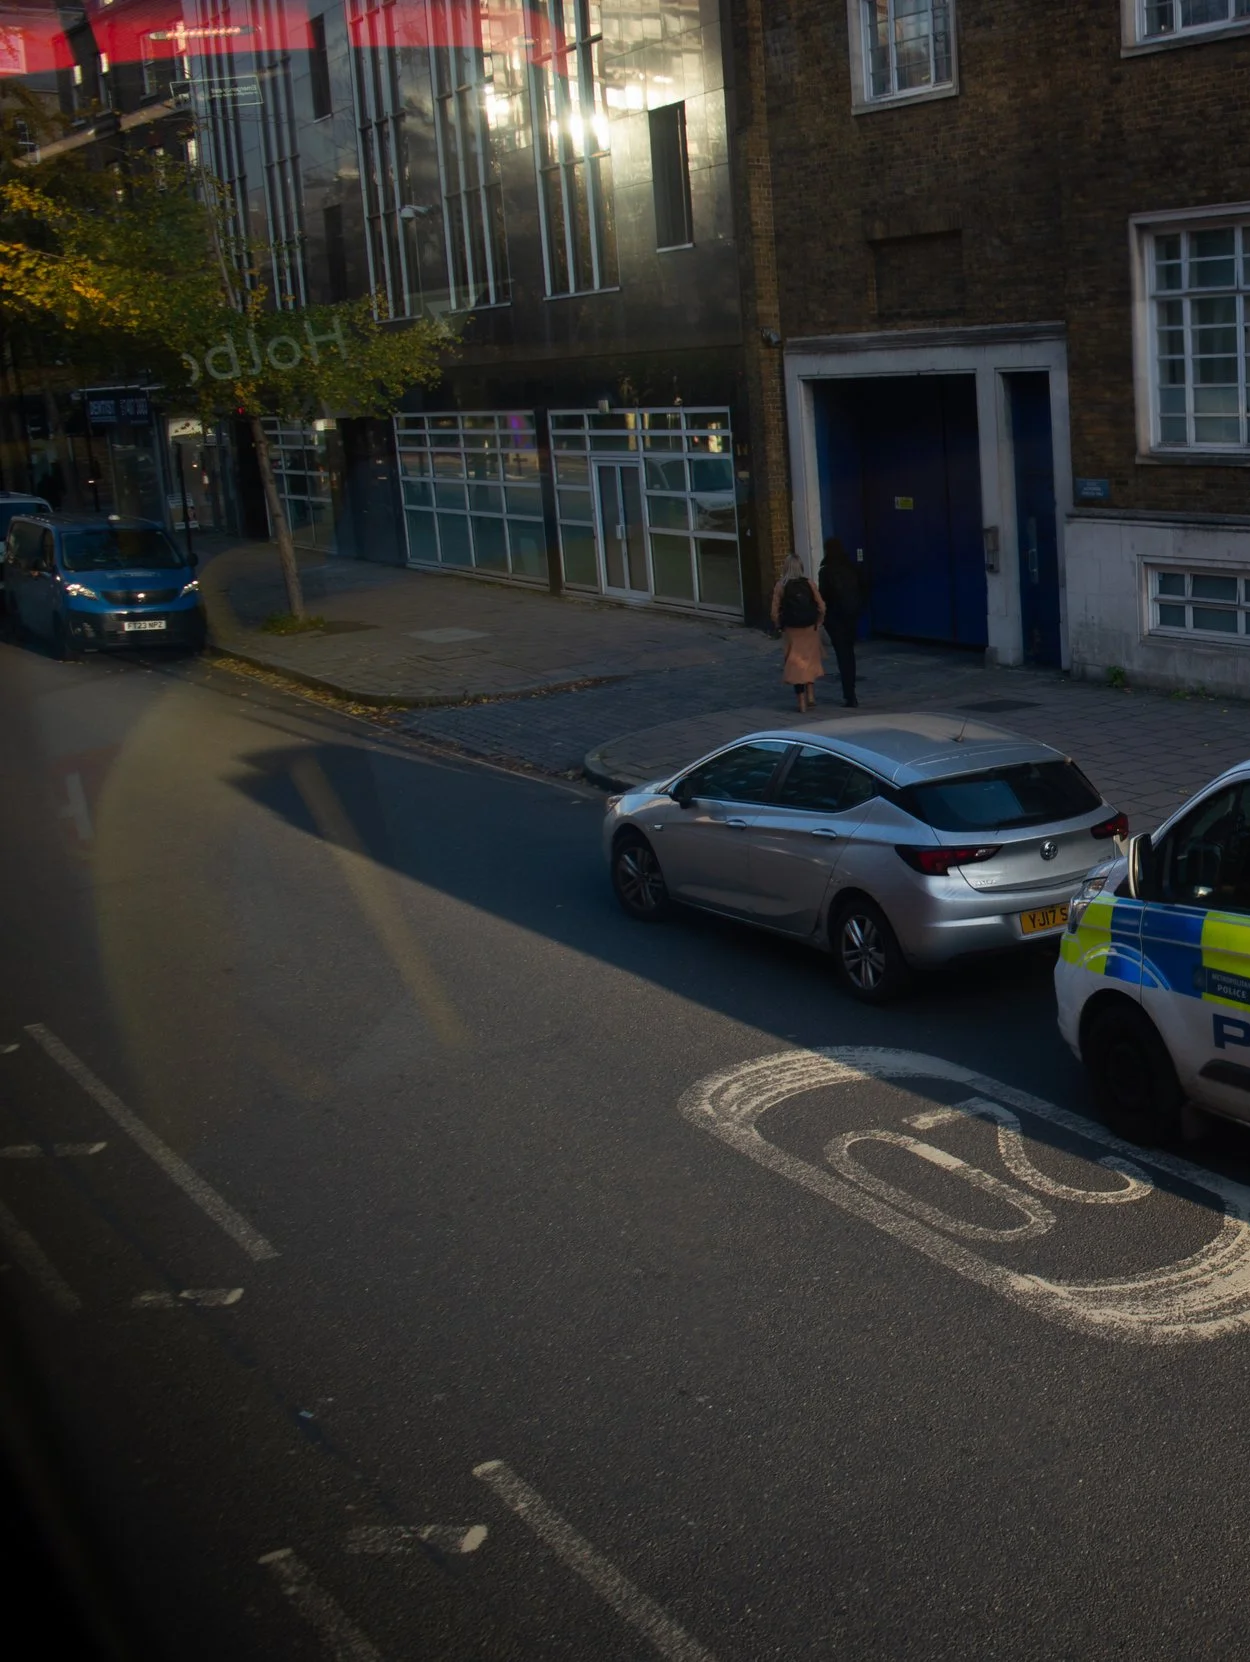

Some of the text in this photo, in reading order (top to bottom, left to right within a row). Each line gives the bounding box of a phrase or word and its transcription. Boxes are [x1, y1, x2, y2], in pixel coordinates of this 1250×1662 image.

[1028, 909, 1056, 928] YJ17
[1217, 984, 1248, 999] POLICE
[823, 1097, 1154, 1242] 20
